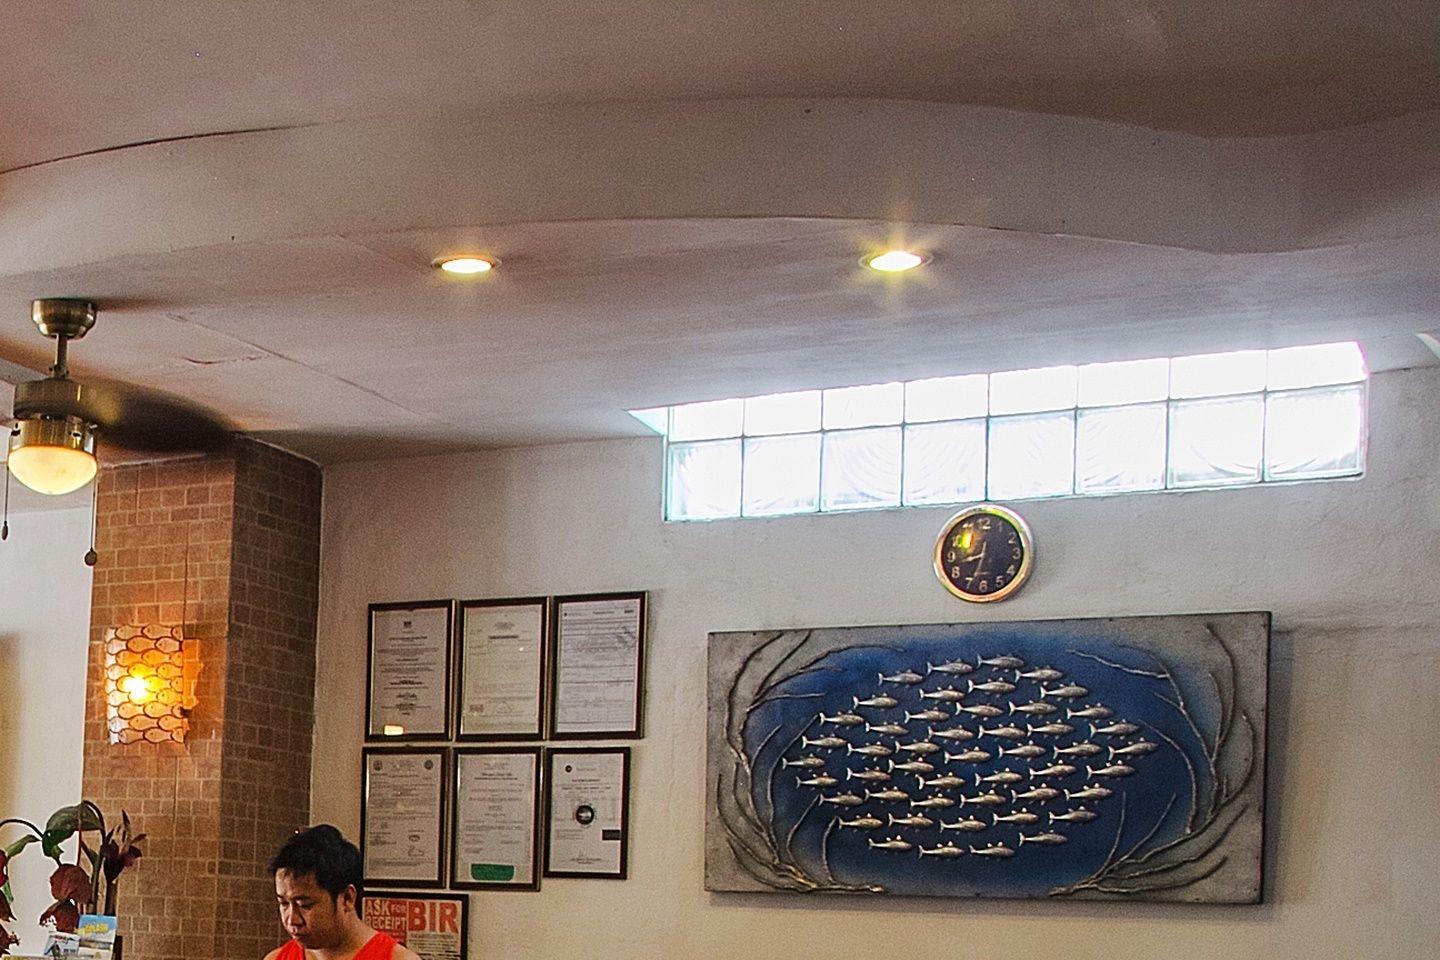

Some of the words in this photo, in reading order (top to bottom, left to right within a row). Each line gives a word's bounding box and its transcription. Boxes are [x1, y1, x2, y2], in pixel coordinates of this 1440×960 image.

[947, 551, 956, 563] 9
[1013, 548, 1021, 560] 3
[951, 566, 960, 578] 8
[979, 580, 988, 593] 6
[366, 899, 390, 916] ASK
[391, 904, 406, 914] FOR
[366, 916, 406, 930] RECEIPT
[408, 901, 459, 933] BIR
